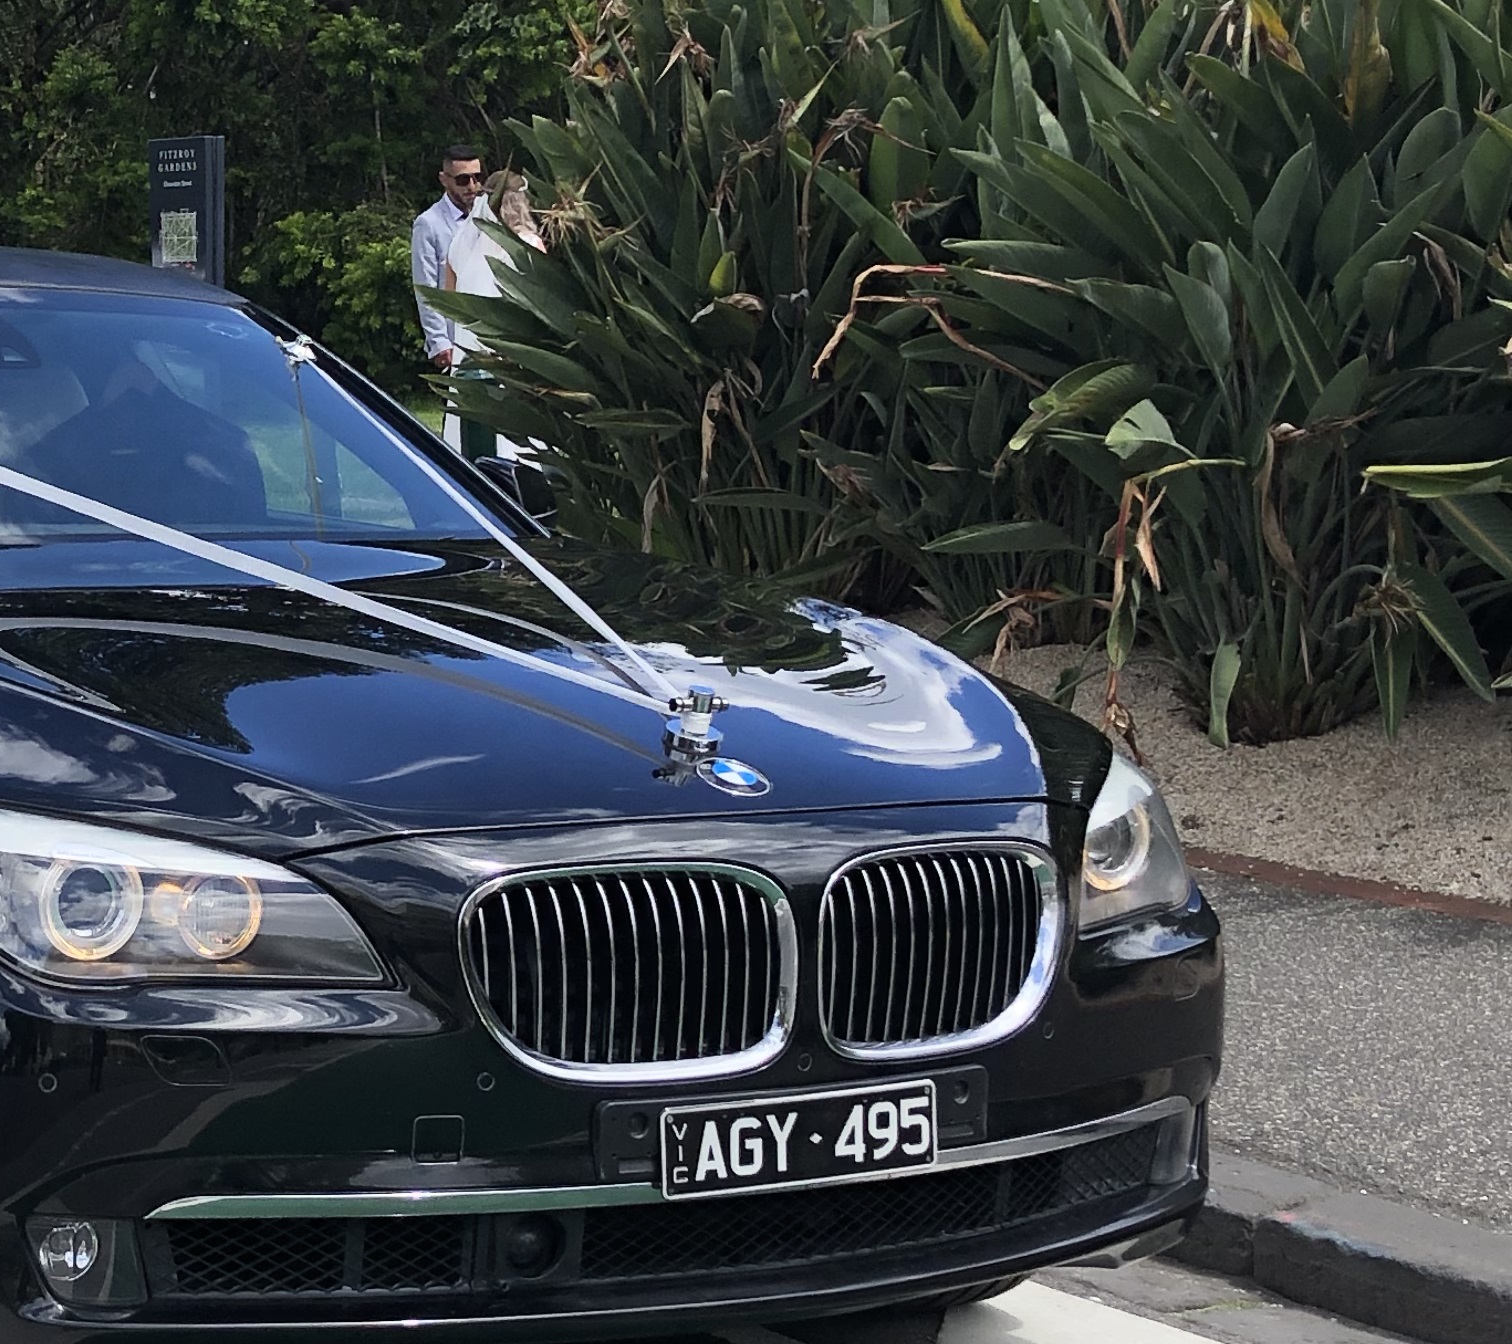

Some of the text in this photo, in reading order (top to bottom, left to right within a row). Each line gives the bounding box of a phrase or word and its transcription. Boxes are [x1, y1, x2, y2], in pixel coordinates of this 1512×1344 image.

[158, 149, 195, 160] FITZROY
[158, 161, 197, 172] GARDENS
[671, 1122, 689, 1184] VIC
[695, 1095, 931, 1182] AGY 495
